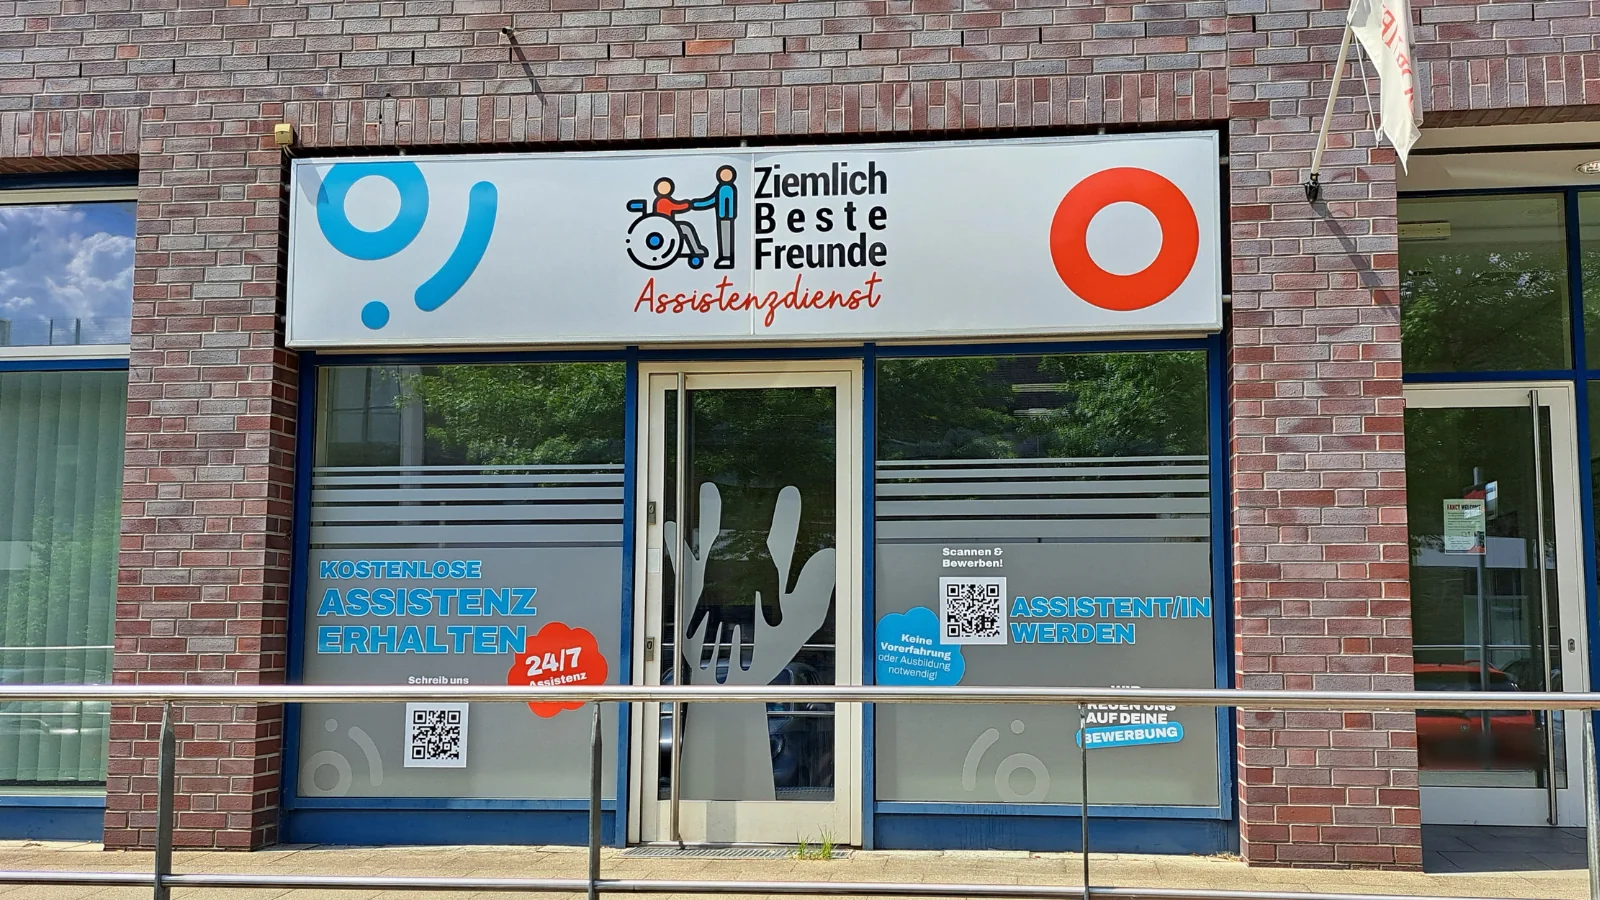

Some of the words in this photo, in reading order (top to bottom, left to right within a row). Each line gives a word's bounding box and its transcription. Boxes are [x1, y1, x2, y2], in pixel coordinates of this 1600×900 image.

[754, 161, 887, 199] Ziemlich
[755, 201, 887, 234] Beste
[755, 232, 887, 270] Freunde
[634, 271, 882, 327] Assistenzdienst
[942, 548, 991, 556] Scannen
[993, 548, 1003, 556] &
[319, 560, 481, 579] KOSTENLOSE
[942, 559, 1003, 568] Bewerben!
[317, 588, 537, 616] ASSISTENZ
[1010, 596, 1211, 619] ASSISTENT/IN
[317, 625, 527, 654] ERHALTEN
[901, 633, 932, 645] Keine
[1010, 623, 1136, 644] WERDEN
[880, 642, 951, 660] Vorerfahrung
[525, 647, 582, 676] 24/7
[878, 654, 898, 663] oder
[900, 655, 951, 672] Ausbildung
[408, 676, 448, 684] Schreib
[888, 666, 938, 681] notwendig!
[1086, 712, 1118, 723] AUF
[1120, 713, 1168, 724] DEINE
[1084, 727, 1178, 743] BEWERBUNG
